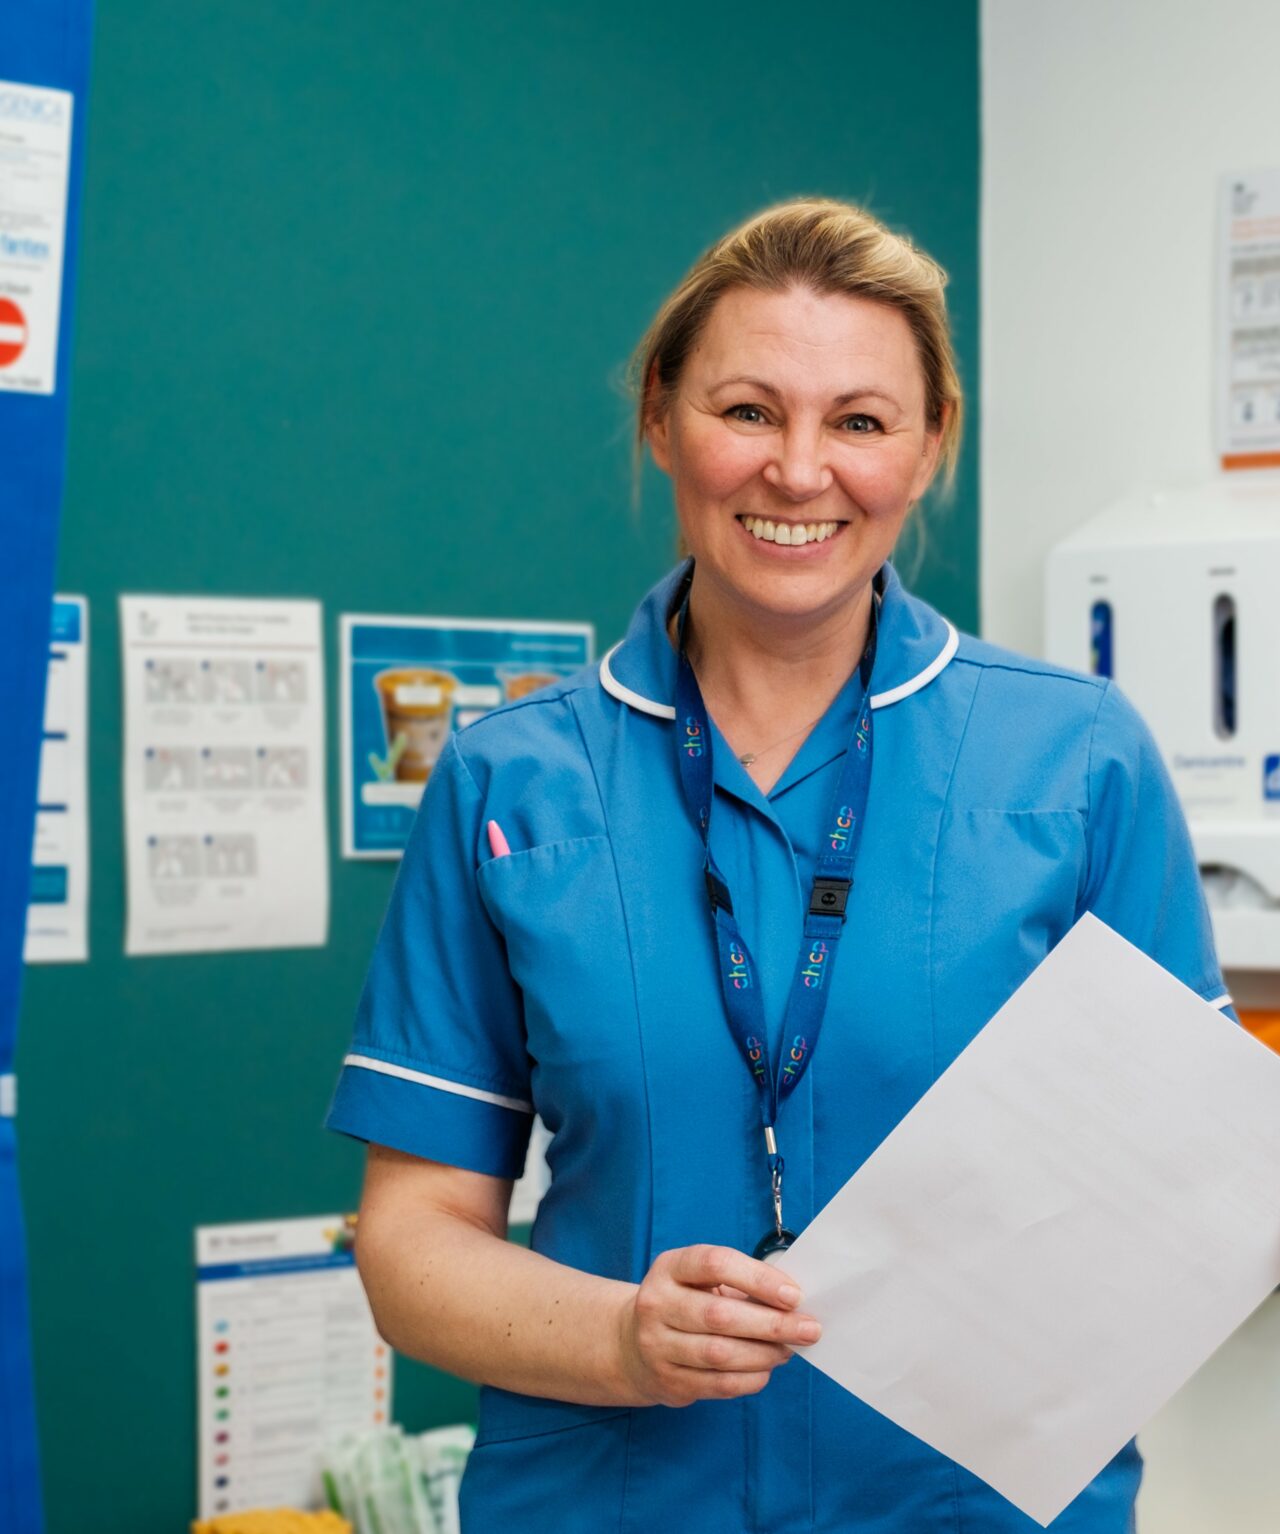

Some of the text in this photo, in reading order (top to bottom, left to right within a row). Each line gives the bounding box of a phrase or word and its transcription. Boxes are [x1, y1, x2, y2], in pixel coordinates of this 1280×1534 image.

[683, 716, 704, 757] chcp
[829, 805, 856, 851] chcp
[729, 942, 749, 989] chcp
[801, 941, 829, 989] chcp
[746, 1035, 766, 1085] chcp
[783, 1035, 808, 1085] chcp
